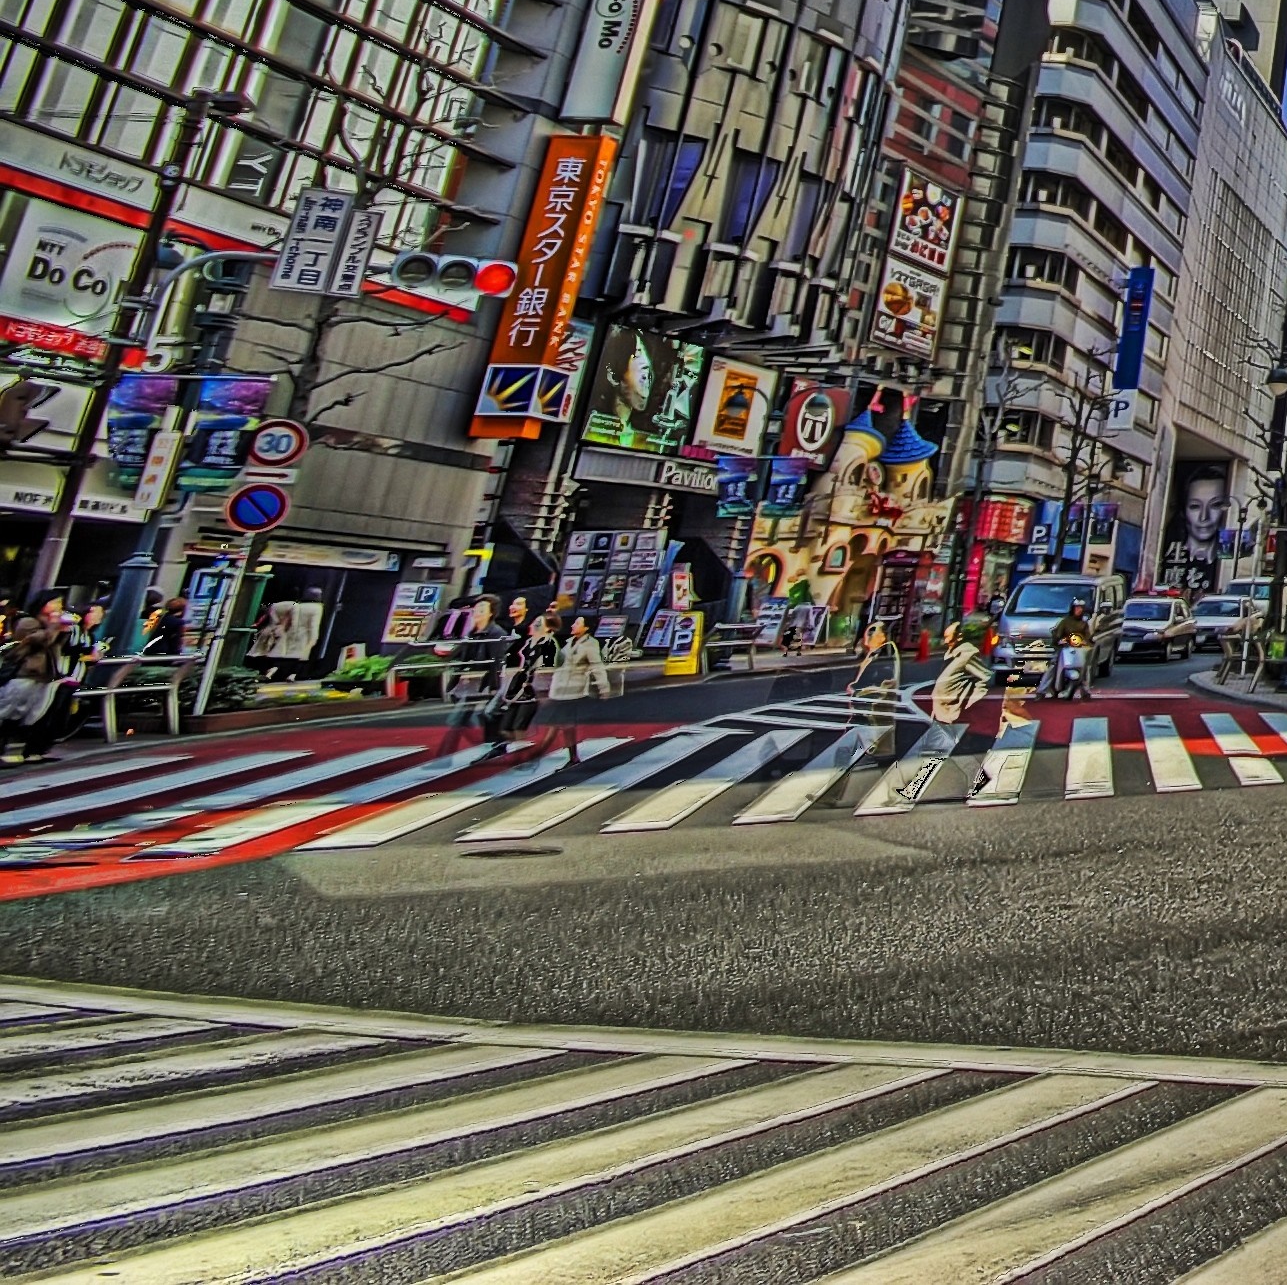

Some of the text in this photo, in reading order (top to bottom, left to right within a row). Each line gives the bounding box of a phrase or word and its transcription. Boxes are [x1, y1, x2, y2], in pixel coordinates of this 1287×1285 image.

[58, 151, 144, 193] ドコモショップ
[36, 237, 67, 257] NTT
[296, 196, 345, 286] 神南一丁目
[508, 156, 588, 348] 東京スター銀行
[549, 160, 609, 347] TOKYO STAR BANK
[1113, 399, 1130, 419] P
[258, 432, 294, 455] 30
[1033, 525, 1047, 544] P
[419, 587, 434, 602] P
